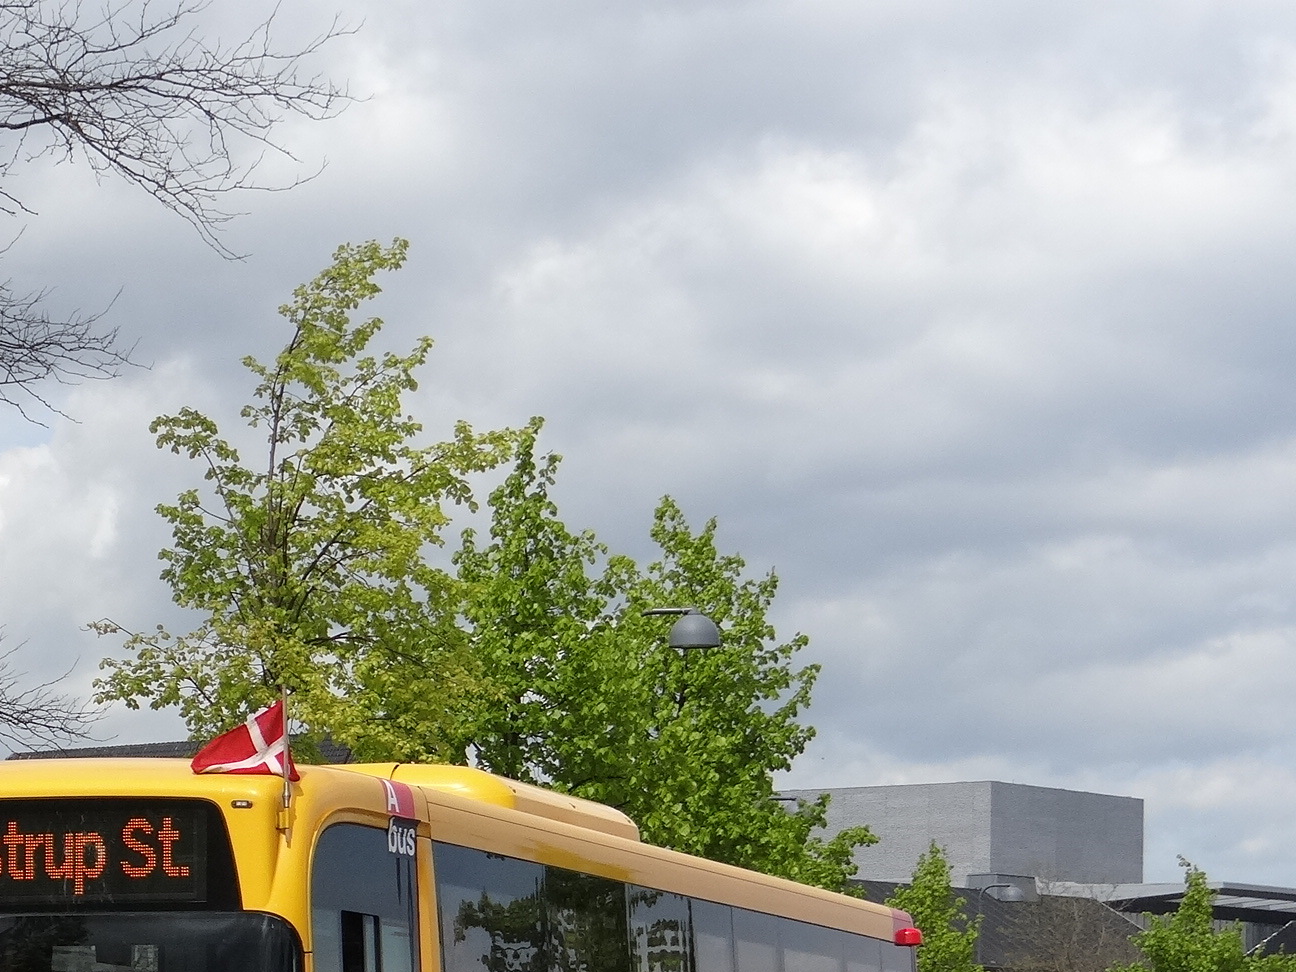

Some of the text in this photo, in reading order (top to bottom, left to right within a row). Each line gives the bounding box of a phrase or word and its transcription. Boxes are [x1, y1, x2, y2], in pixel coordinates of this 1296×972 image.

[382, 779, 400, 813] A
[119, 815, 190, 878] St.
[388, 816, 415, 856] bus
